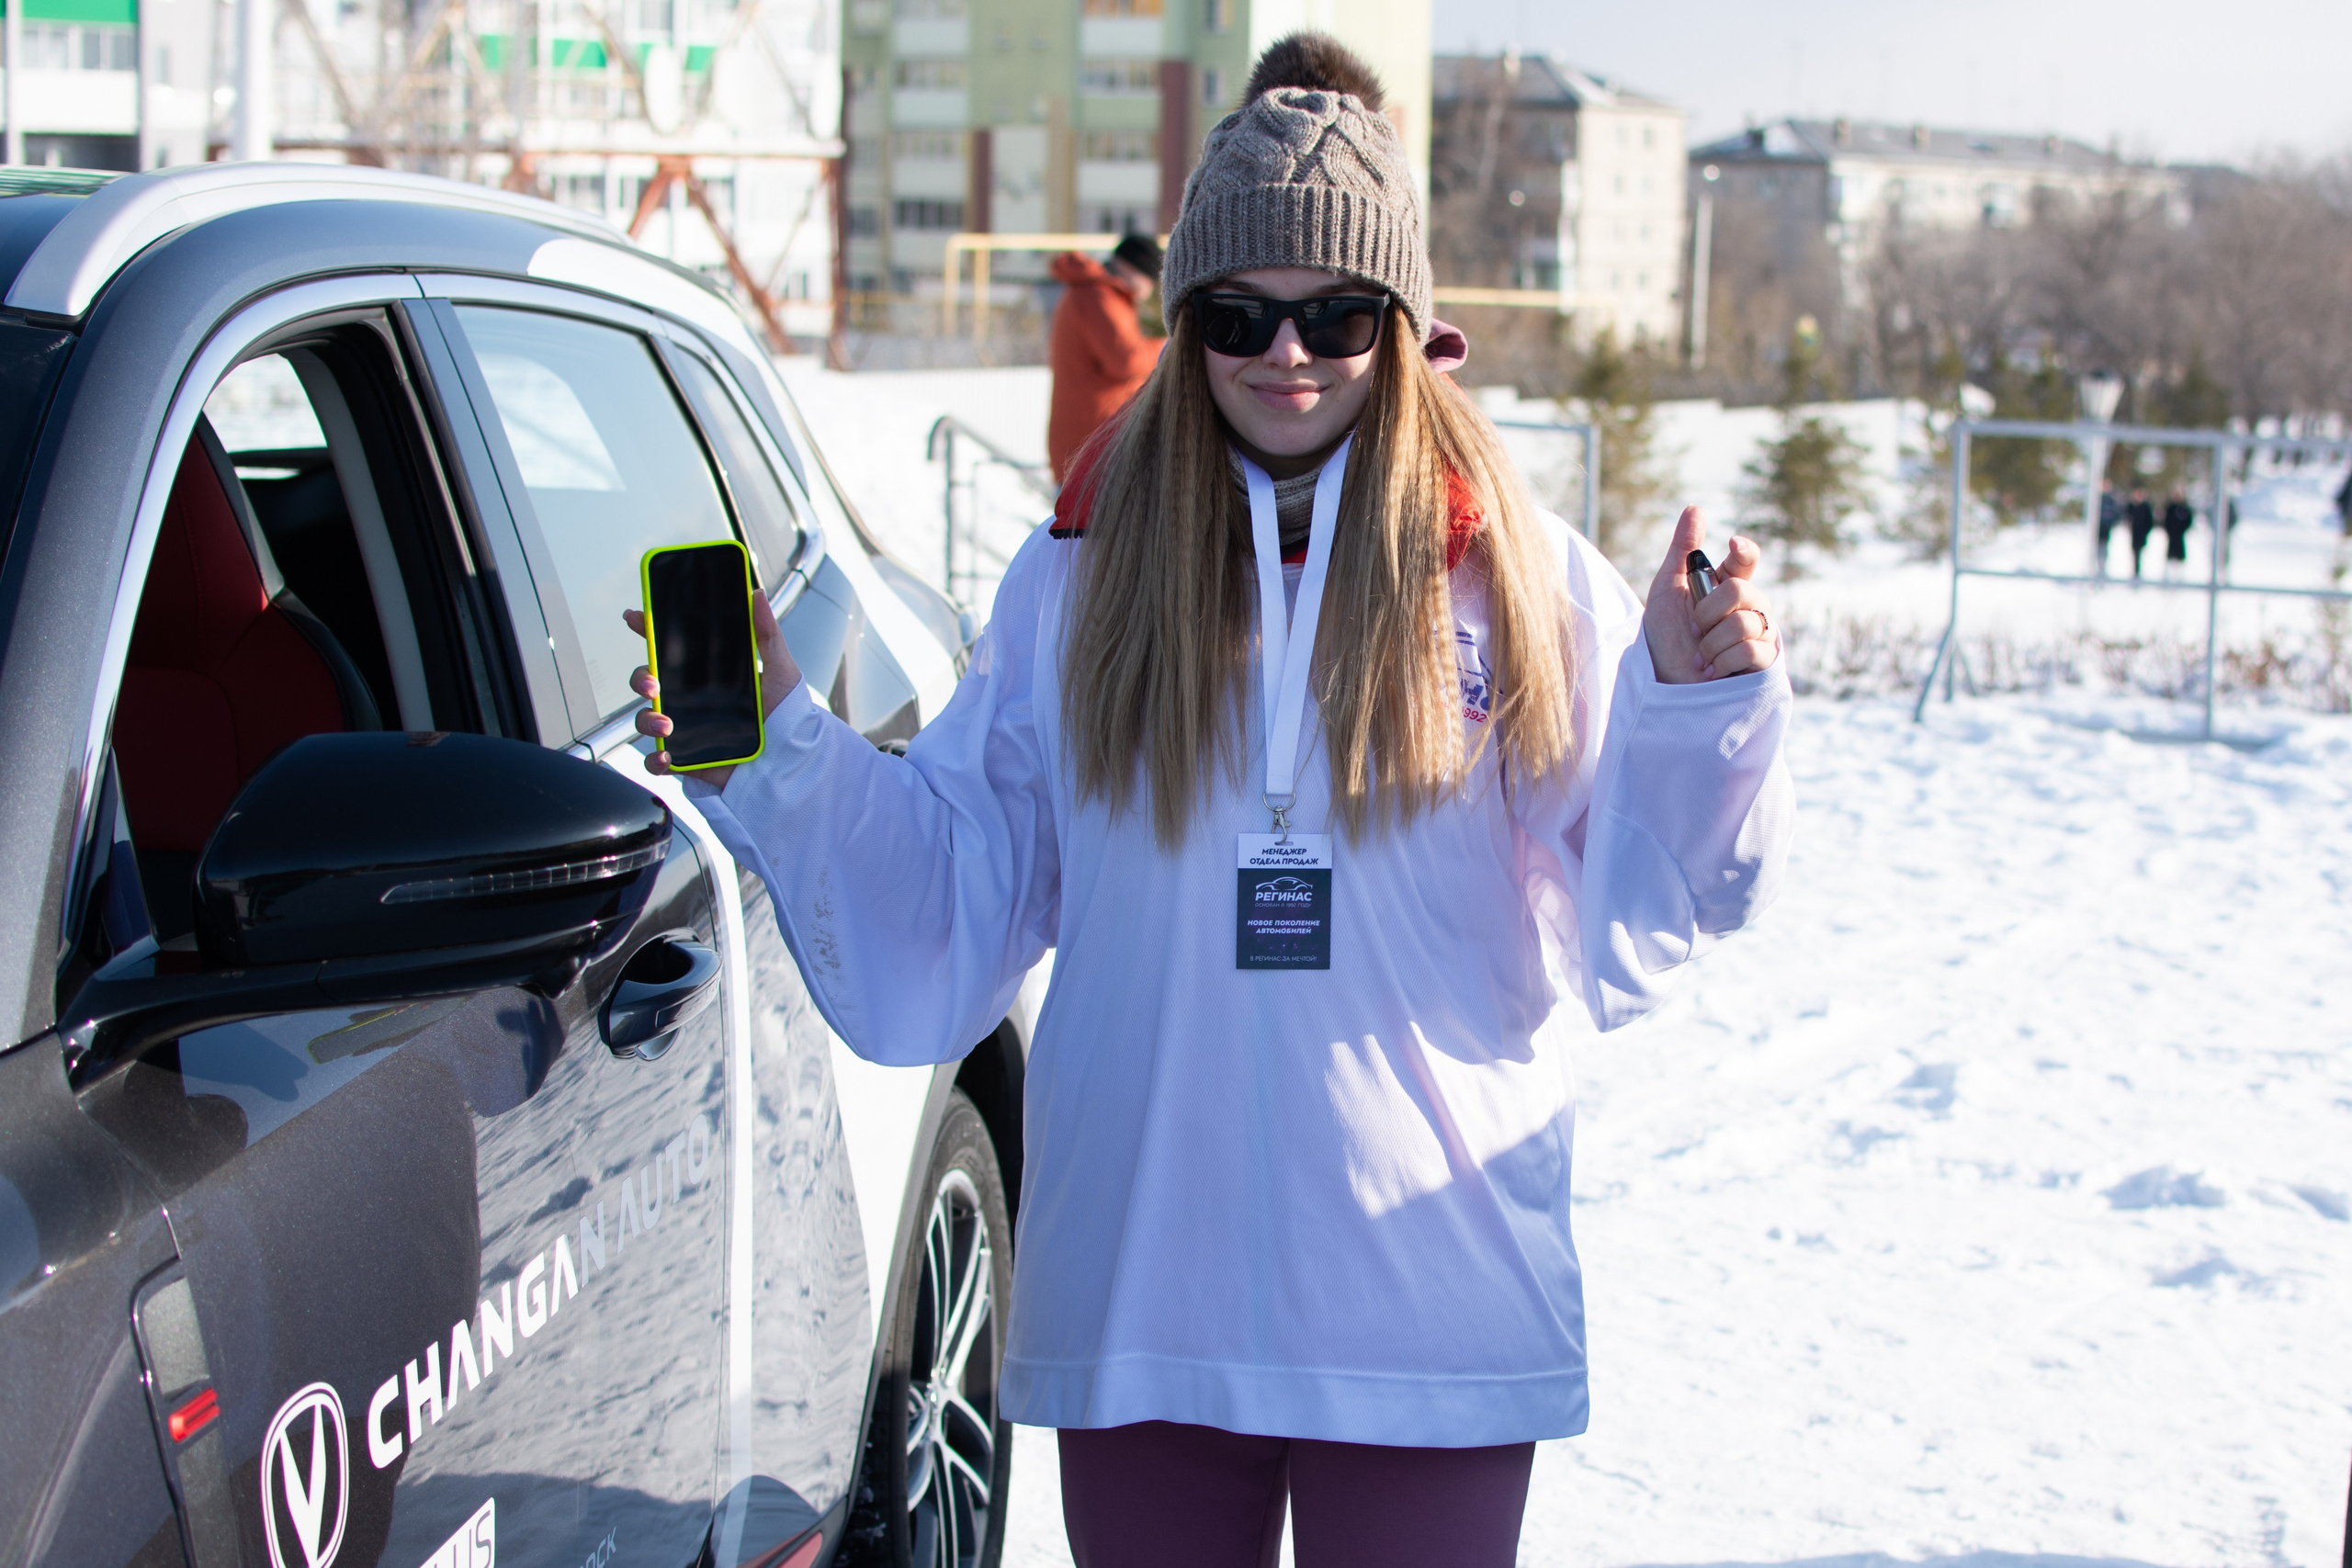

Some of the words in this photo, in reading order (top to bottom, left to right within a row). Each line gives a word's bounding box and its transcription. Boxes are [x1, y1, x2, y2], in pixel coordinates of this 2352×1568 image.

[1261, 848, 1307, 856] МЕНЕДЖЕР
[1250, 858, 1281, 866] ОТДЕЛА
[1282, 858, 1319, 866] ПРОДАЖ
[1255, 892, 1313, 902] РЕГИНАС
[368, 1200, 606, 1470] CHANGAN
[616, 1113, 710, 1255] AUTO
